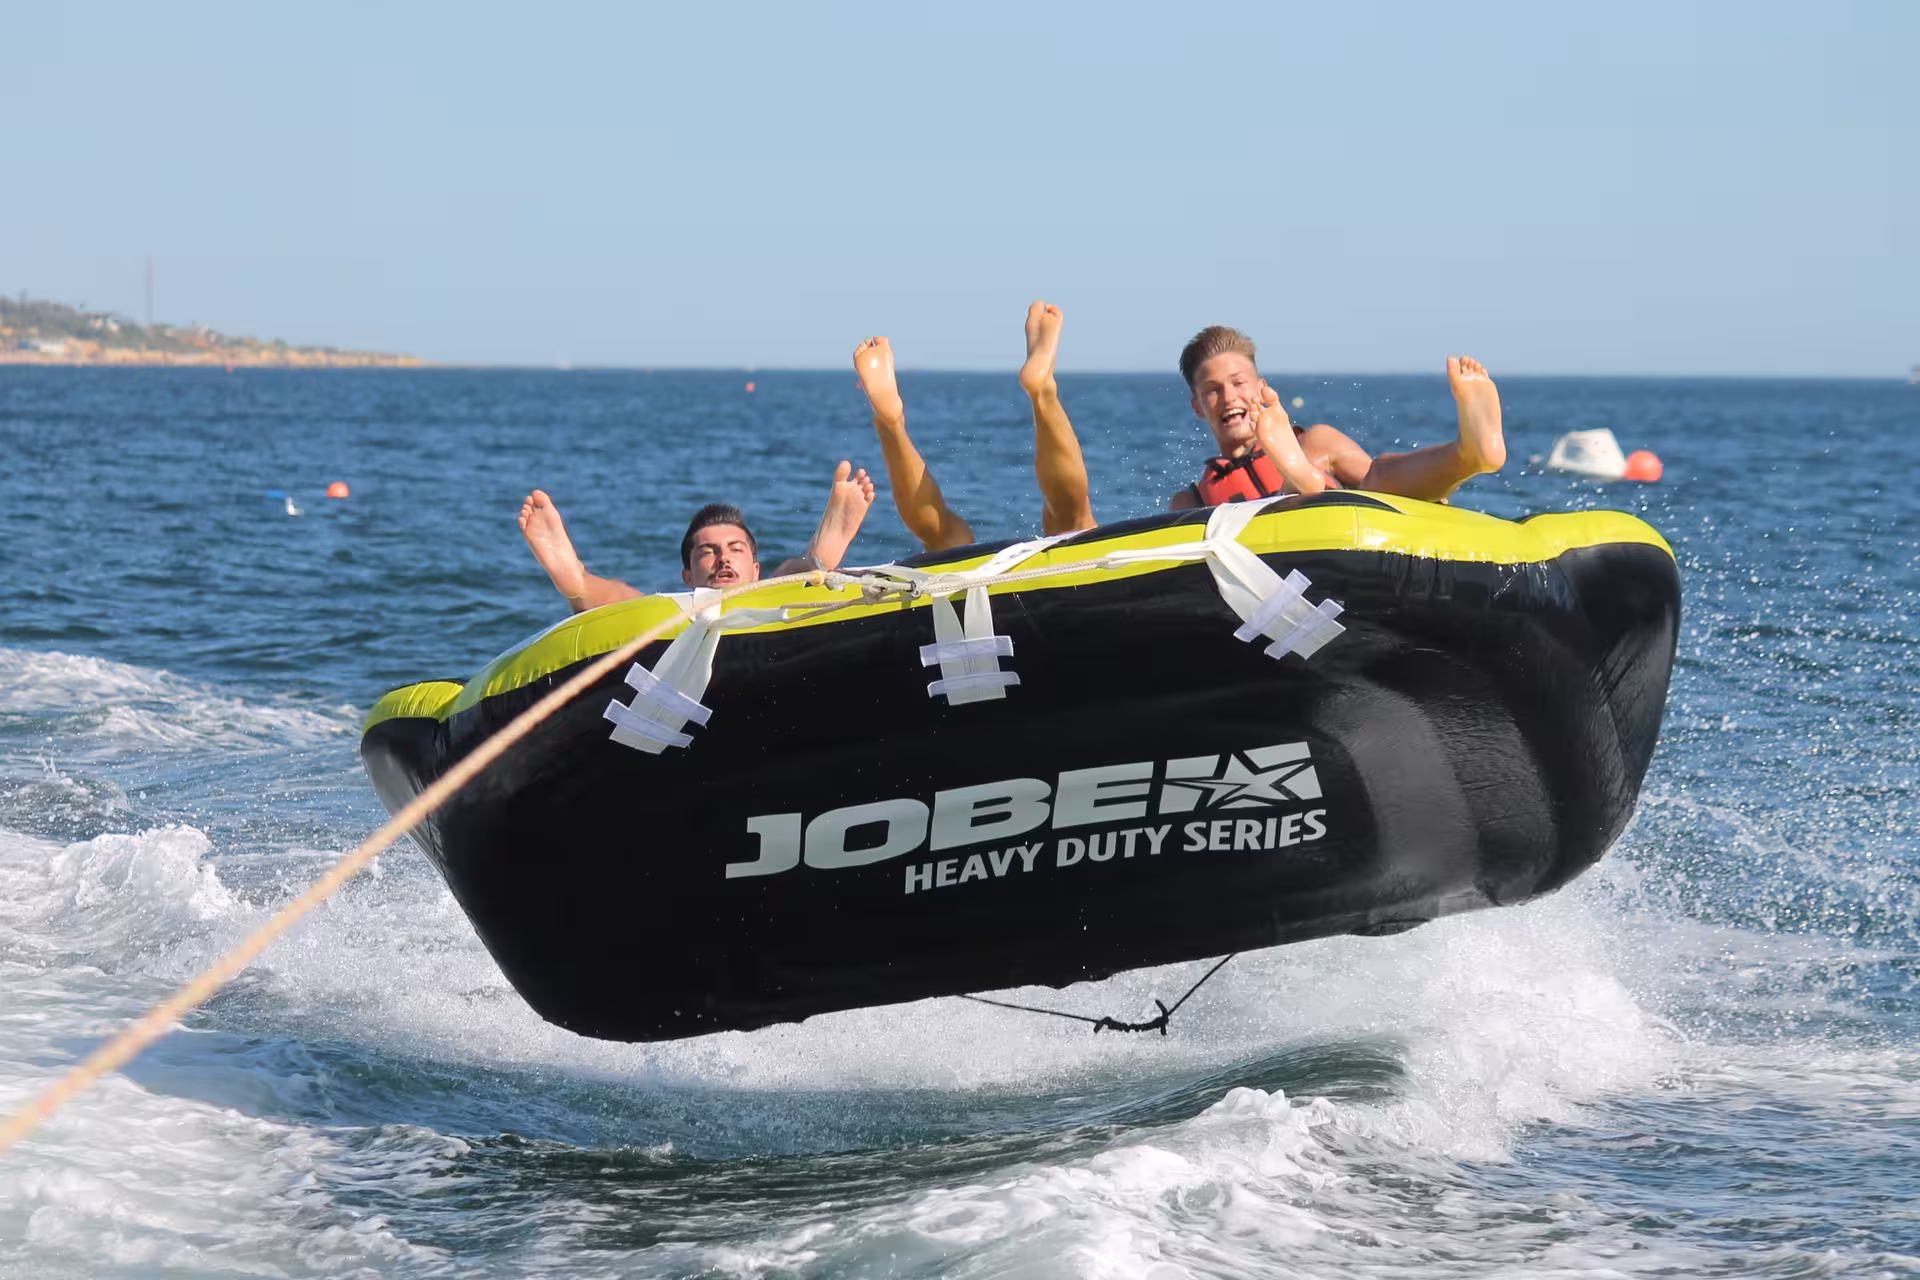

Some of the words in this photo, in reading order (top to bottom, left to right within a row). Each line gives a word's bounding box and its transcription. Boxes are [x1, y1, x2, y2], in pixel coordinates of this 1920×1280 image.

[725, 761, 1154, 879] JOBE
[905, 842, 1044, 894] HEAVY
[1057, 825, 1172, 868] DUTY
[1183, 809, 1327, 852] SERIES
